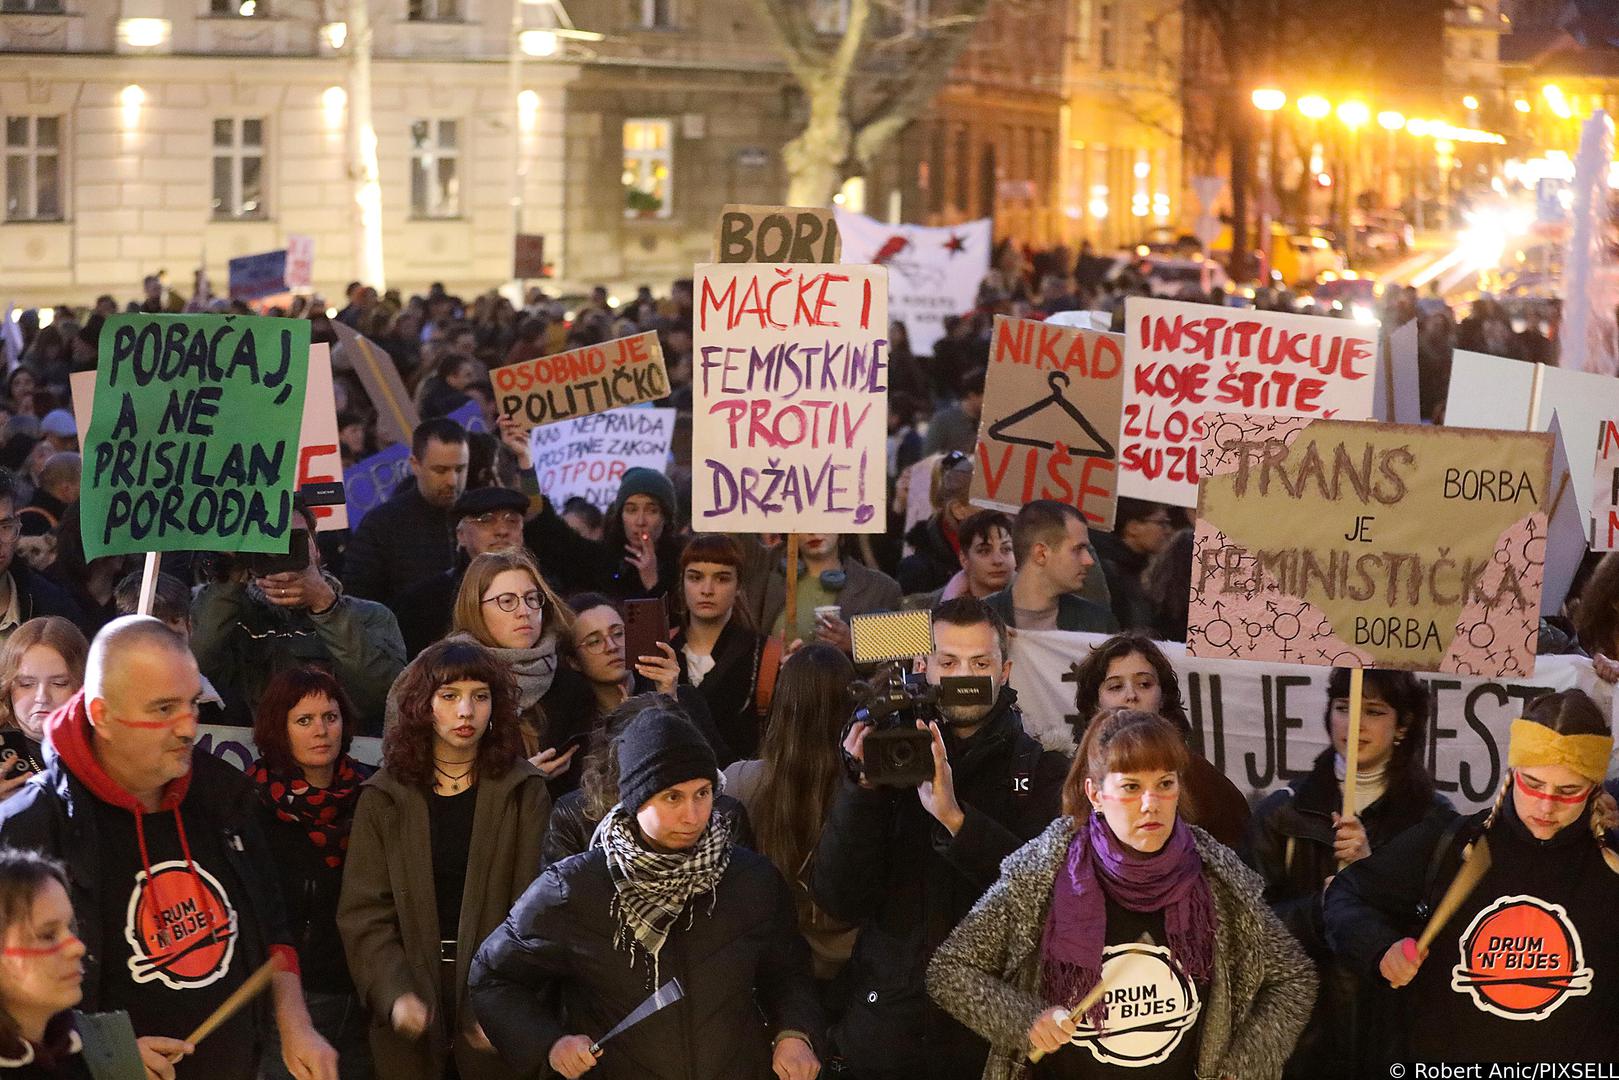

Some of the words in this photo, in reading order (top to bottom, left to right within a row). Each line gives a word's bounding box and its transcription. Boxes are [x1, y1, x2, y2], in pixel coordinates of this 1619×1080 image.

[699, 267, 849, 331] MAČKE
[859, 278, 872, 330] I
[109, 315, 293, 405] POBAČAJ,
[496, 347, 607, 392] OSOBNO
[612, 335, 649, 366] JE
[995, 319, 1123, 379] NIKAD
[1140, 315, 1374, 380] INSTITUCIJE
[502, 362, 664, 424] POLITIČKO
[1134, 362, 1211, 406] KOJE
[111, 392, 138, 440] A
[158, 386, 223, 436] NE
[570, 413, 664, 437] NEPRAVDA
[708, 399, 872, 449] PROTIV
[1124, 404, 1203, 443] ZLOS
[93, 440, 286, 489] PRISILAN
[607, 439, 667, 456] ZAKON
[1224, 438, 1416, 505] TRANS
[1444, 468, 1538, 504] BORBA
[541, 460, 628, 494] OTPOR
[703, 446, 875, 525] DRŽAVE!
[978, 440, 1116, 523] VIŠE
[104, 486, 290, 545] POROĐAJ
[1344, 516, 1375, 542] JE
[1199, 546, 1526, 612] FEMINISTIČKA
[1355, 616, 1443, 653] BORBA
[1488, 937, 1543, 952] DRUM
[1505, 953, 1561, 970] BIJES
[1121, 998, 1176, 1018] BIJES
